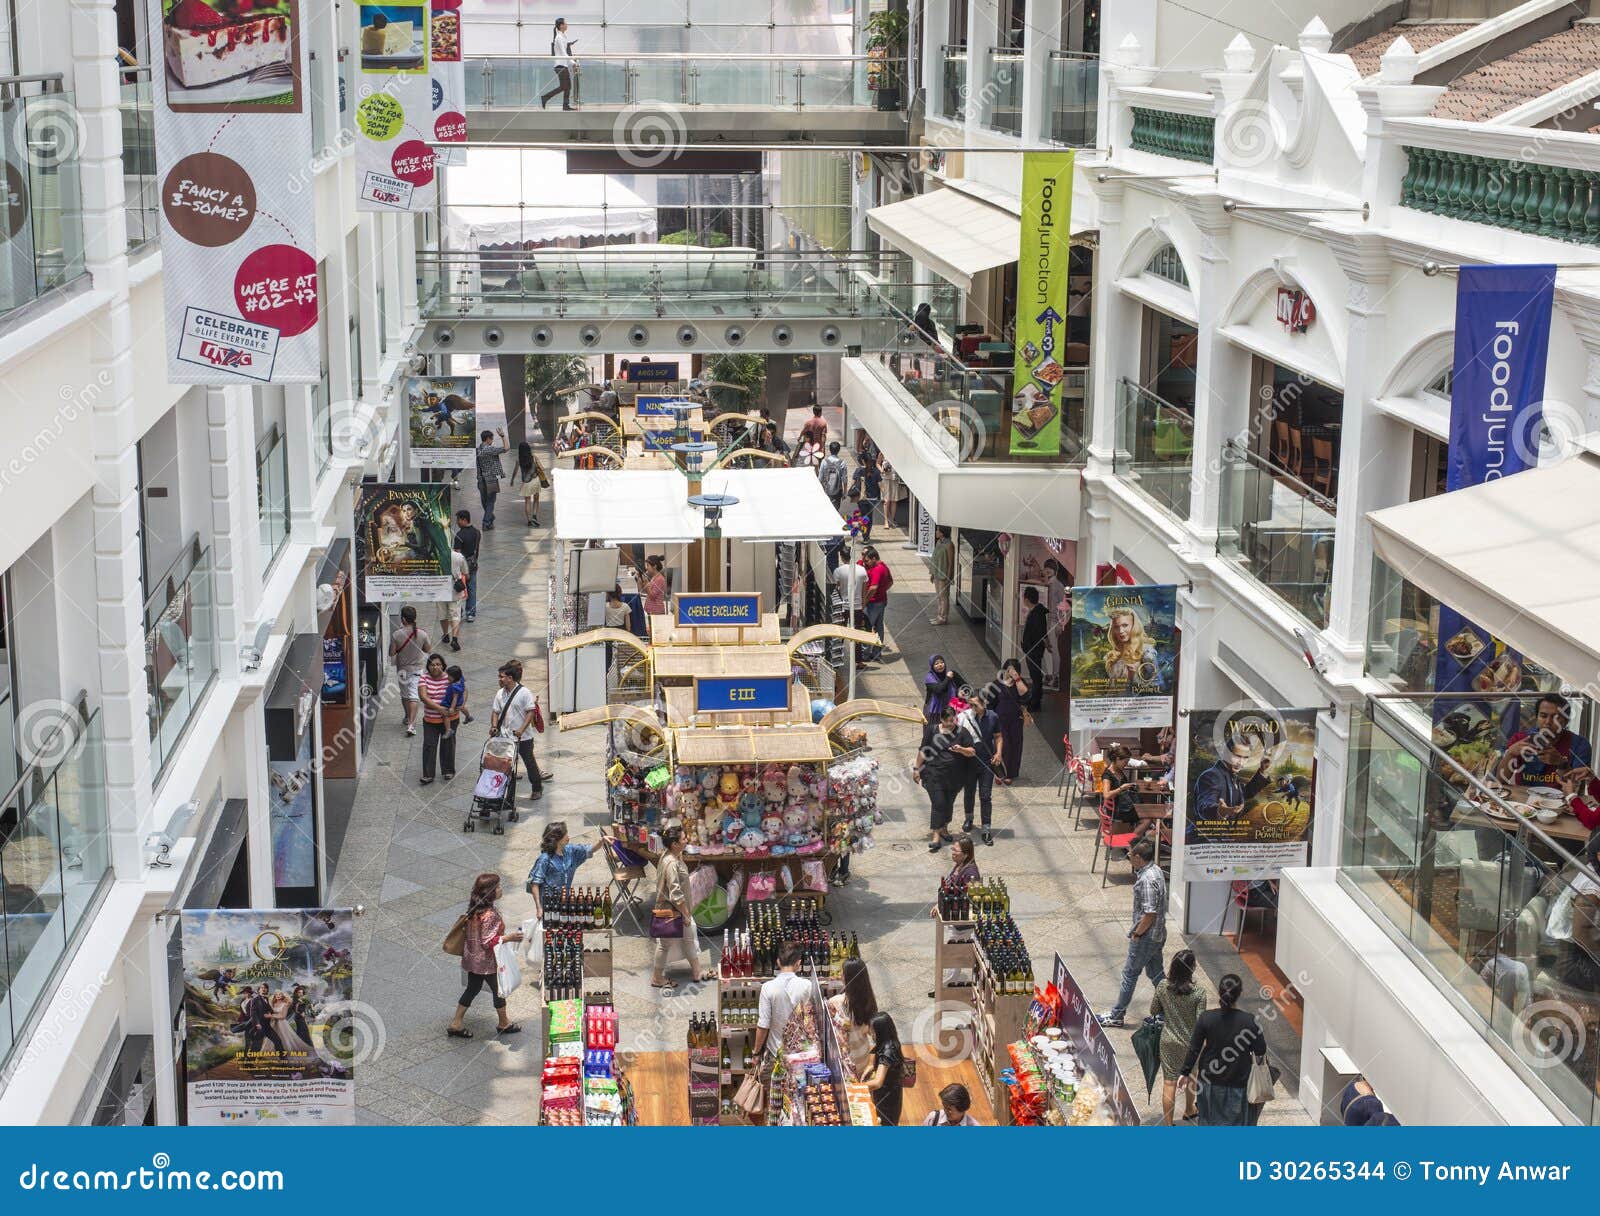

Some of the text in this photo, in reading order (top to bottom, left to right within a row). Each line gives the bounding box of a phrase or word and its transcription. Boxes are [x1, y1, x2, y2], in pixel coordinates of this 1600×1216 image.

[394, 154, 433, 167] WE'RE AT
[397, 162, 433, 174] #02-47
[371, 175, 409, 190] CELEBRATE
[178, 179, 244, 206] FANCY A
[171, 193, 249, 222] 3-SOME?
[240, 273, 318, 297] WE'RE AT
[245, 289, 317, 312] #02-47
[195, 315, 270, 340] CELEBRATE
[201, 328, 261, 348] LIFE EVERYDAY
[687, 605, 749, 617] CHERIE EXCELLENCE
[729, 688, 756, 701] E III
[1226, 720, 1280, 737] WIZARD
[236, 1050, 245, 1058] IN
[247, 1049, 281, 1057] CINEMAS
